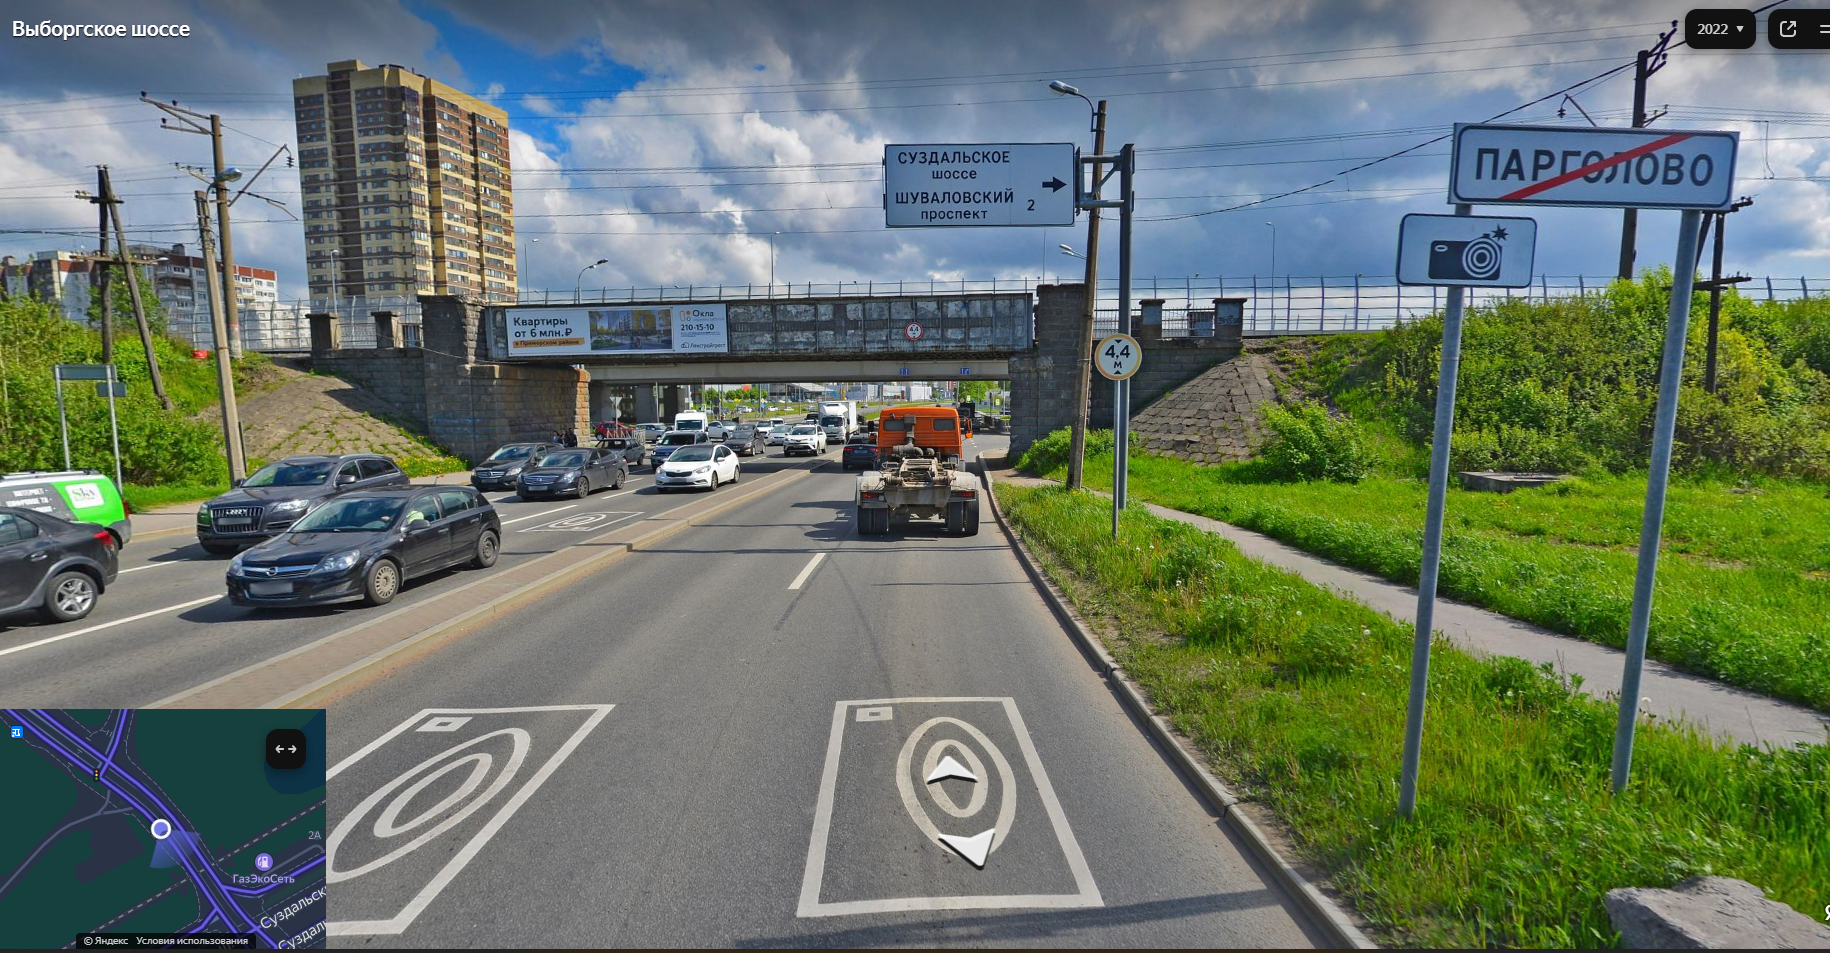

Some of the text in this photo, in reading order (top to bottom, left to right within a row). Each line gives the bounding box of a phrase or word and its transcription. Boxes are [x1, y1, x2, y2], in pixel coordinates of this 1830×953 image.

[897, 151, 1010, 166] СУЗДАЛЬСКОЕ
[1475, 147, 1714, 187] ПАРГОЛОВО
[931, 168, 977, 180] шоссе
[895, 187, 1014, 205] ШУВАЛОВСКИЙ
[1026, 199, 1036, 212] 2
[920, 209, 988, 223] проспект
[692, 309, 714, 317] Окла
[513, 317, 568, 328] Квартиры
[680, 323, 715, 331] 210-15-10
[514, 330, 526, 338] от
[530, 328, 537, 338] 6
[1104, 344, 1131, 360] 4,4
